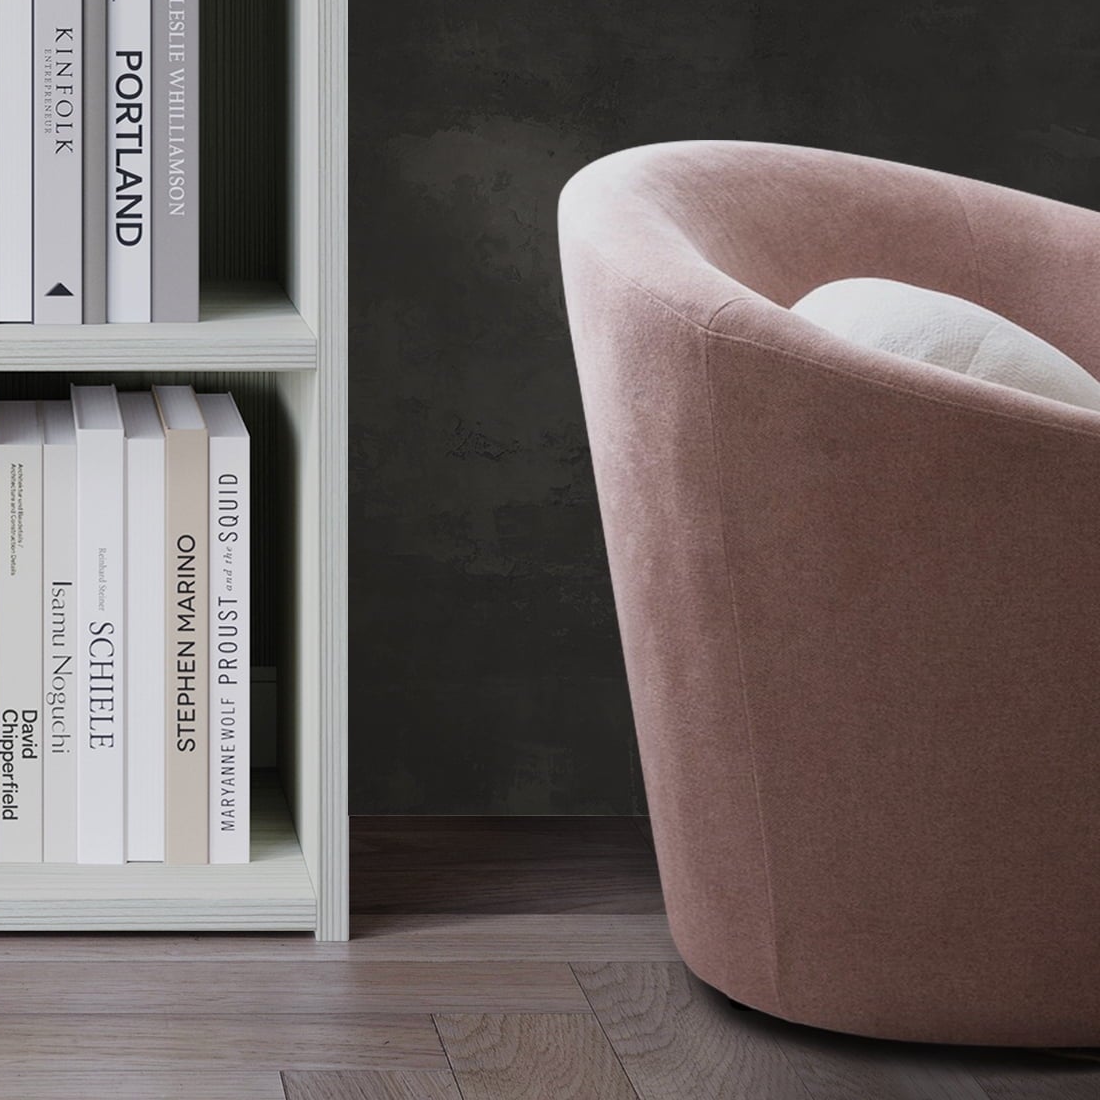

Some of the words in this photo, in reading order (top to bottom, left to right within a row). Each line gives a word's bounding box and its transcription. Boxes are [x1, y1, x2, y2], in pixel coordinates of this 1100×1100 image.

[44, 49, 52, 134] ENTREPRENEUR
[56, 27, 74, 154] KINFOLK
[116, 50, 143, 247] PORTLAND
[169, 67, 185, 217] WHILLIAMSON
[218, 472, 239, 543] SQUID
[98, 548, 106, 582] Reinhard
[98, 584, 106, 611] Steiner
[177, 534, 196, 633] MARINO
[224, 546, 233, 564] the
[224, 569, 233, 592] and
[51, 581, 72, 647] Isamu
[218, 596, 239, 684] PROUST
[46, 654, 72, 754] Noguchi
[88, 621, 115, 750] SCHIELE
[177, 640, 196, 752] STEPHEN
[221, 698, 235, 740] WOLF
[21, 709, 37, 760] David
[221, 744, 235, 831] MARYANNE
